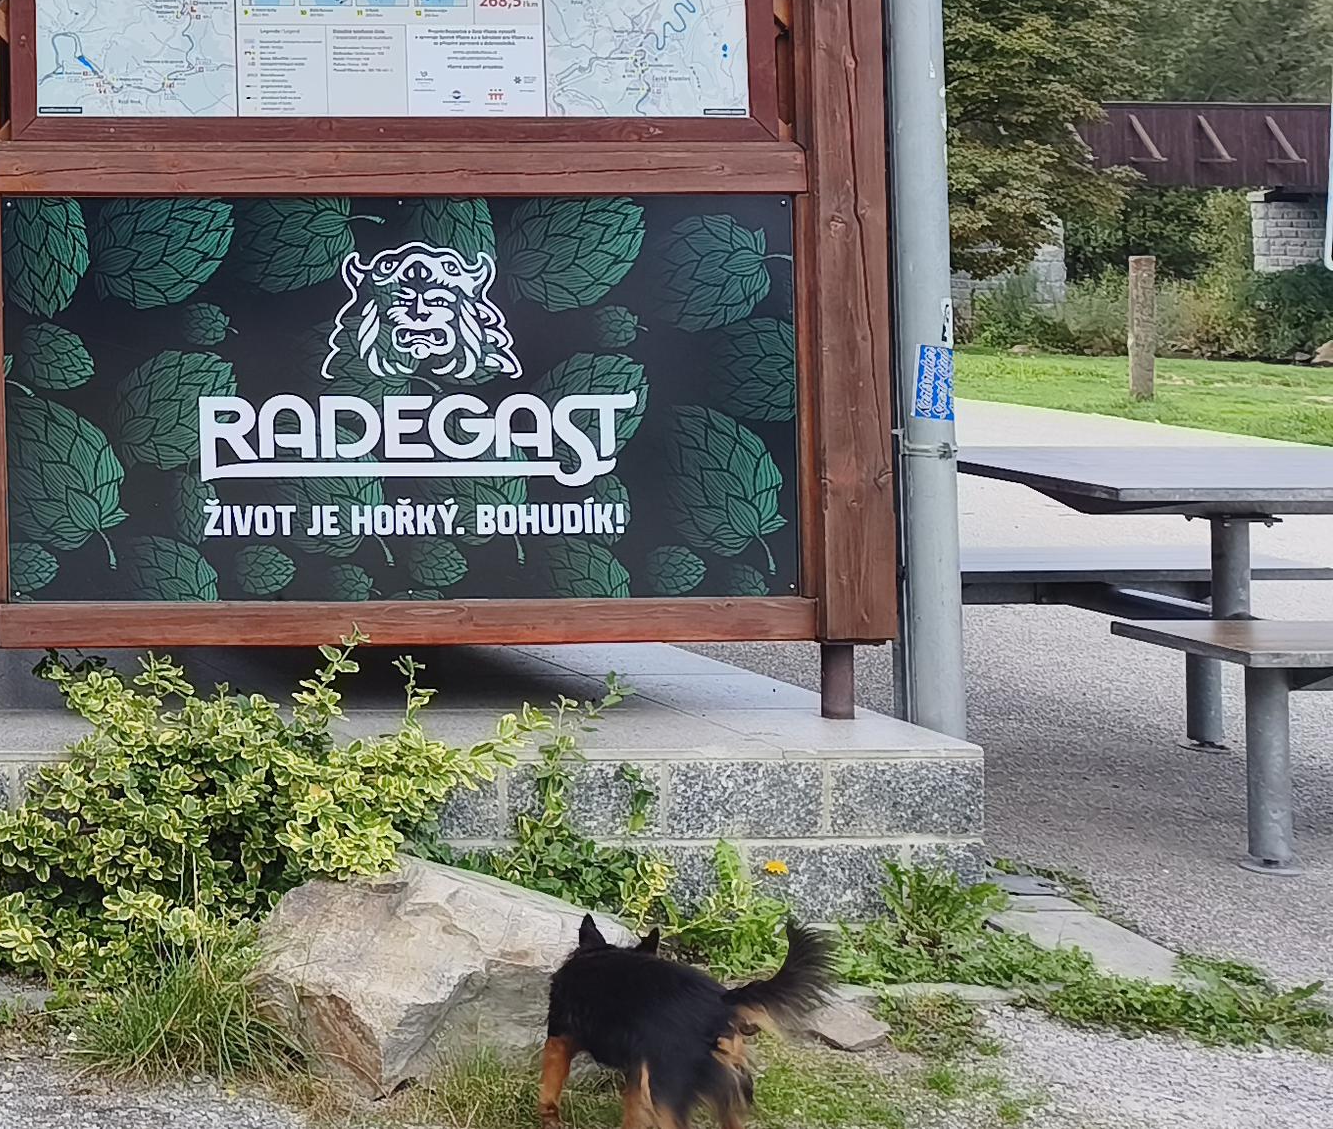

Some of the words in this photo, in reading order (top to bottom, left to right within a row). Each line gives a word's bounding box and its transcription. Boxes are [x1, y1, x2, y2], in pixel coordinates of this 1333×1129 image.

[198, 390, 637, 486] RADEGAST
[203, 499, 296, 537] ŽIVOT
[306, 505, 340, 536] JE
[350, 499, 466, 537] HOŘKÝ.
[475, 499, 626, 537] BOHUDÍK!
